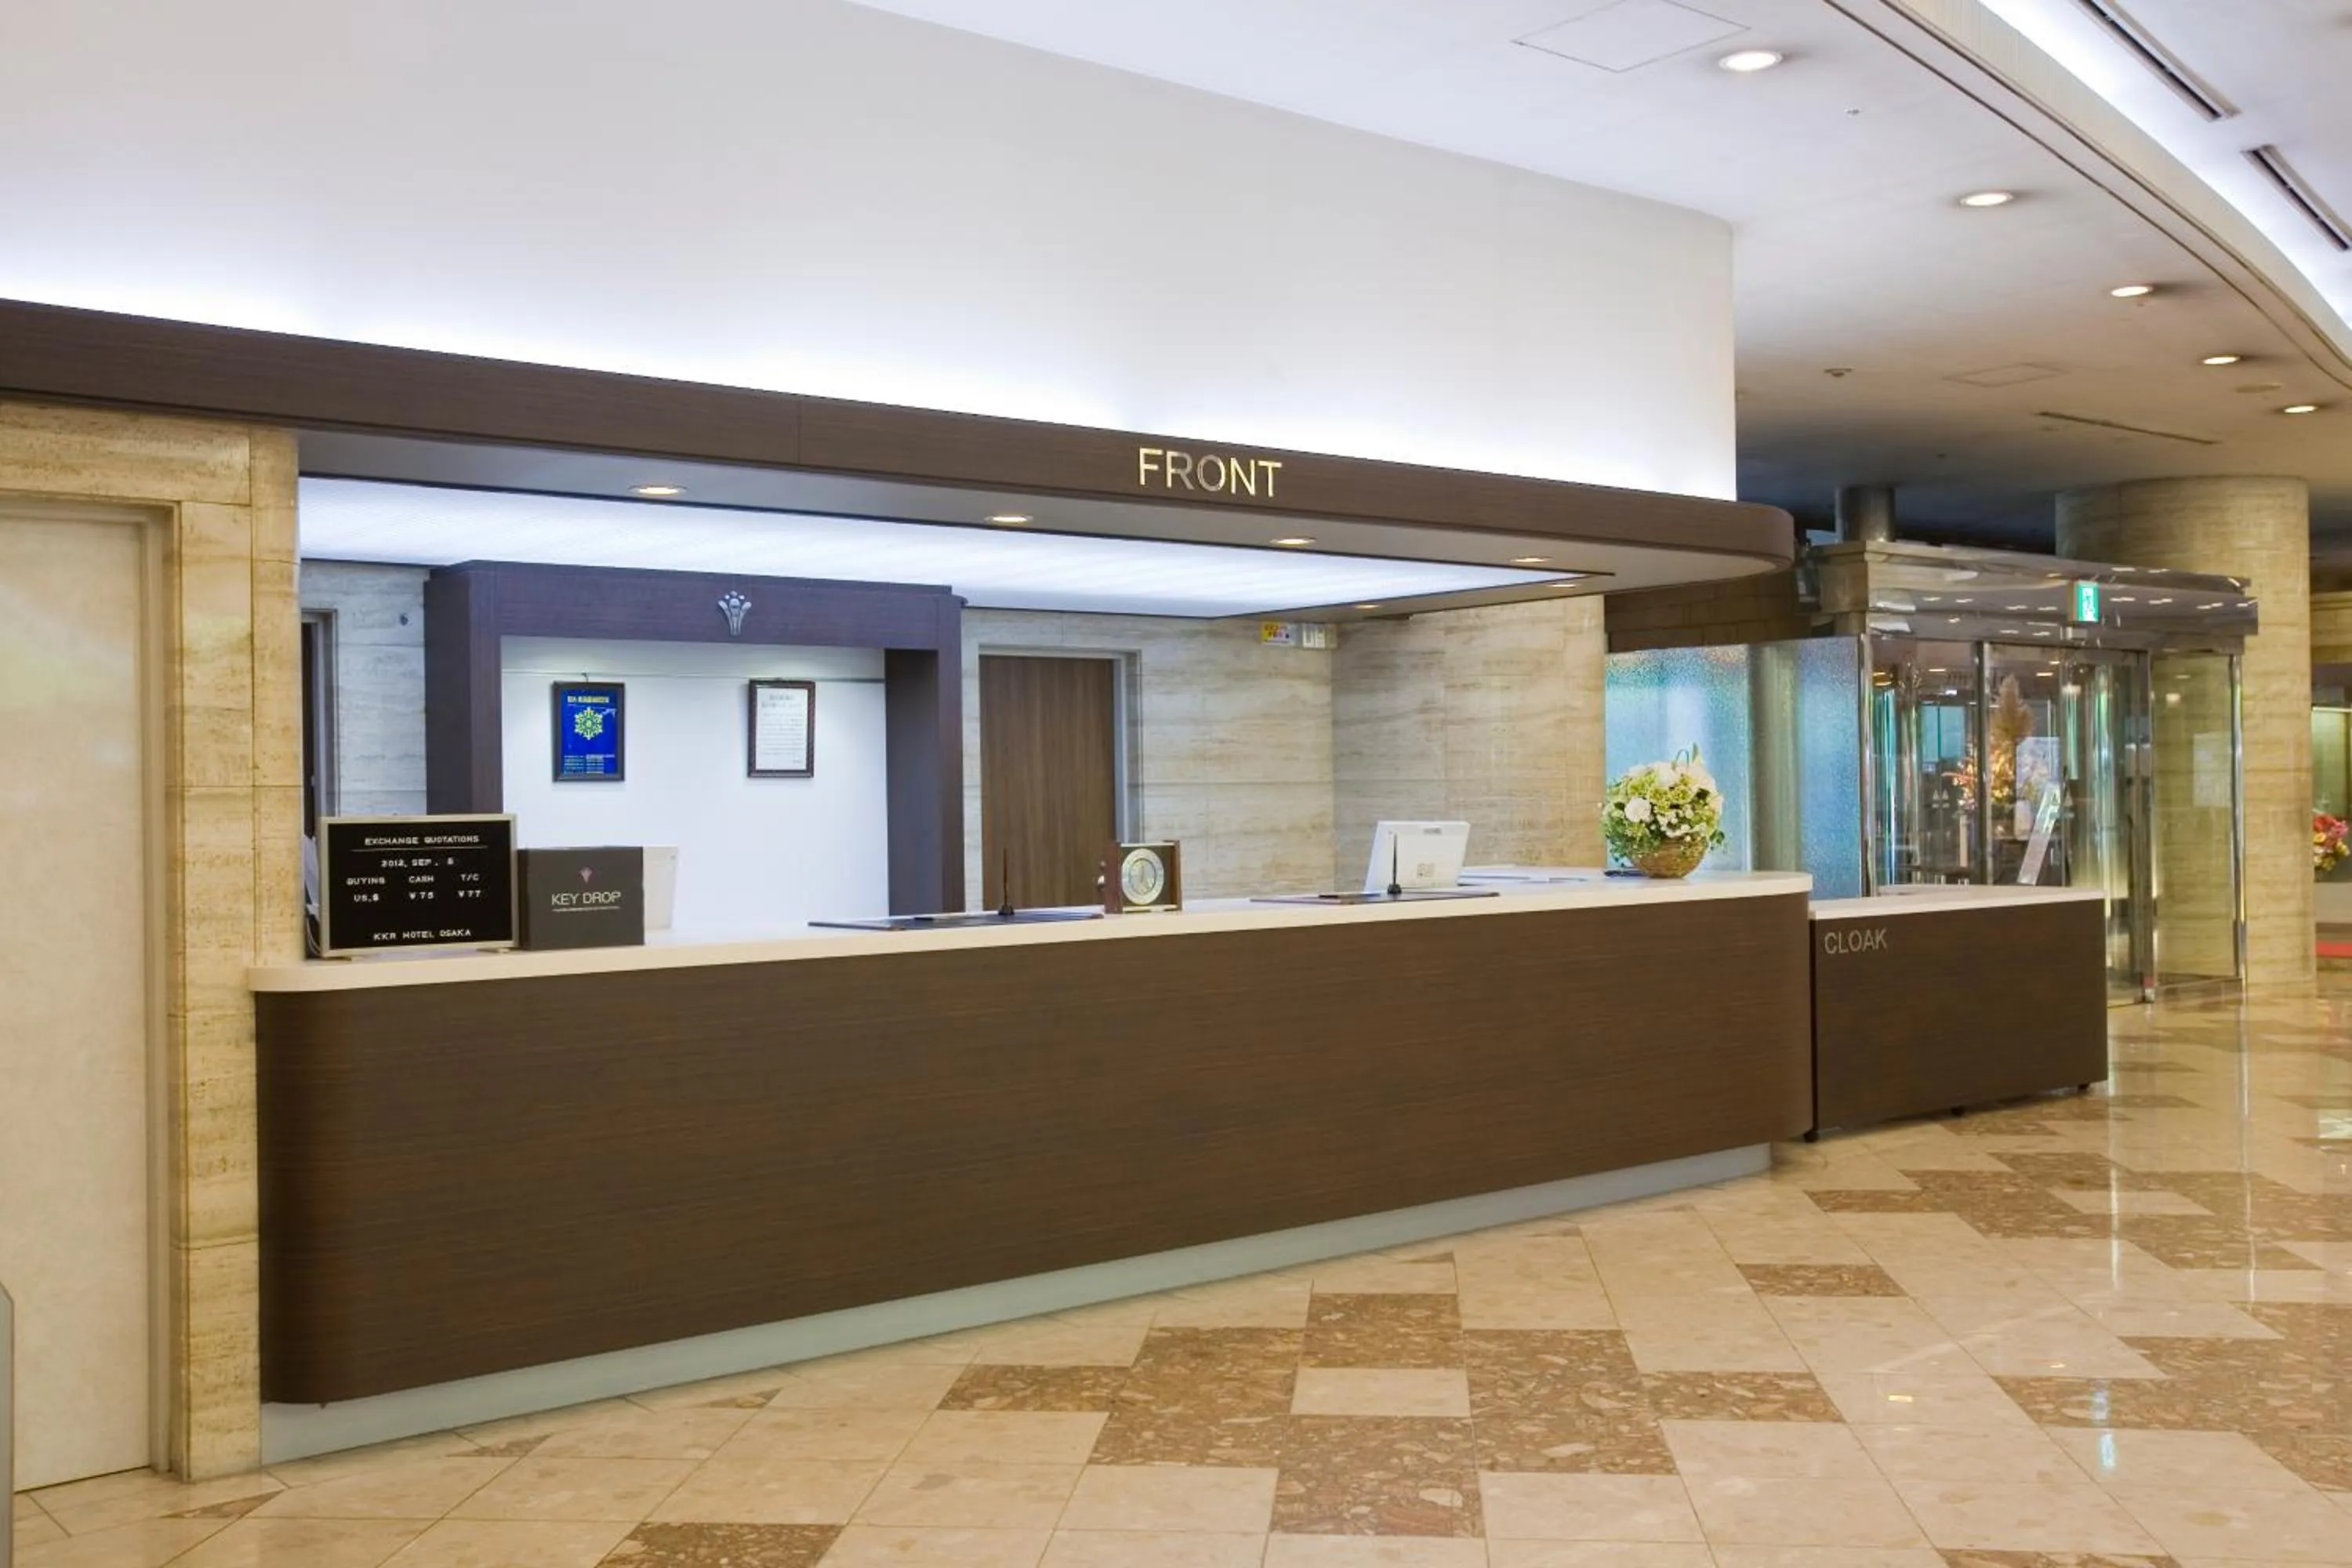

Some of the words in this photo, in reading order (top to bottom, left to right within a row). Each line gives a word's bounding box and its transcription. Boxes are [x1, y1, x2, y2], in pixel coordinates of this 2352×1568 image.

[1139, 447, 1283, 497] FRONT
[365, 837, 419, 846] EXCHANGE
[424, 835, 480, 844] QUOTATIONS
[551, 892, 579, 906] KEY
[583, 891, 621, 904] DROP
[373, 932, 397, 941] KKR
[402, 931, 434, 939] HOTEL
[1824, 927, 1888, 954] CLOAK
